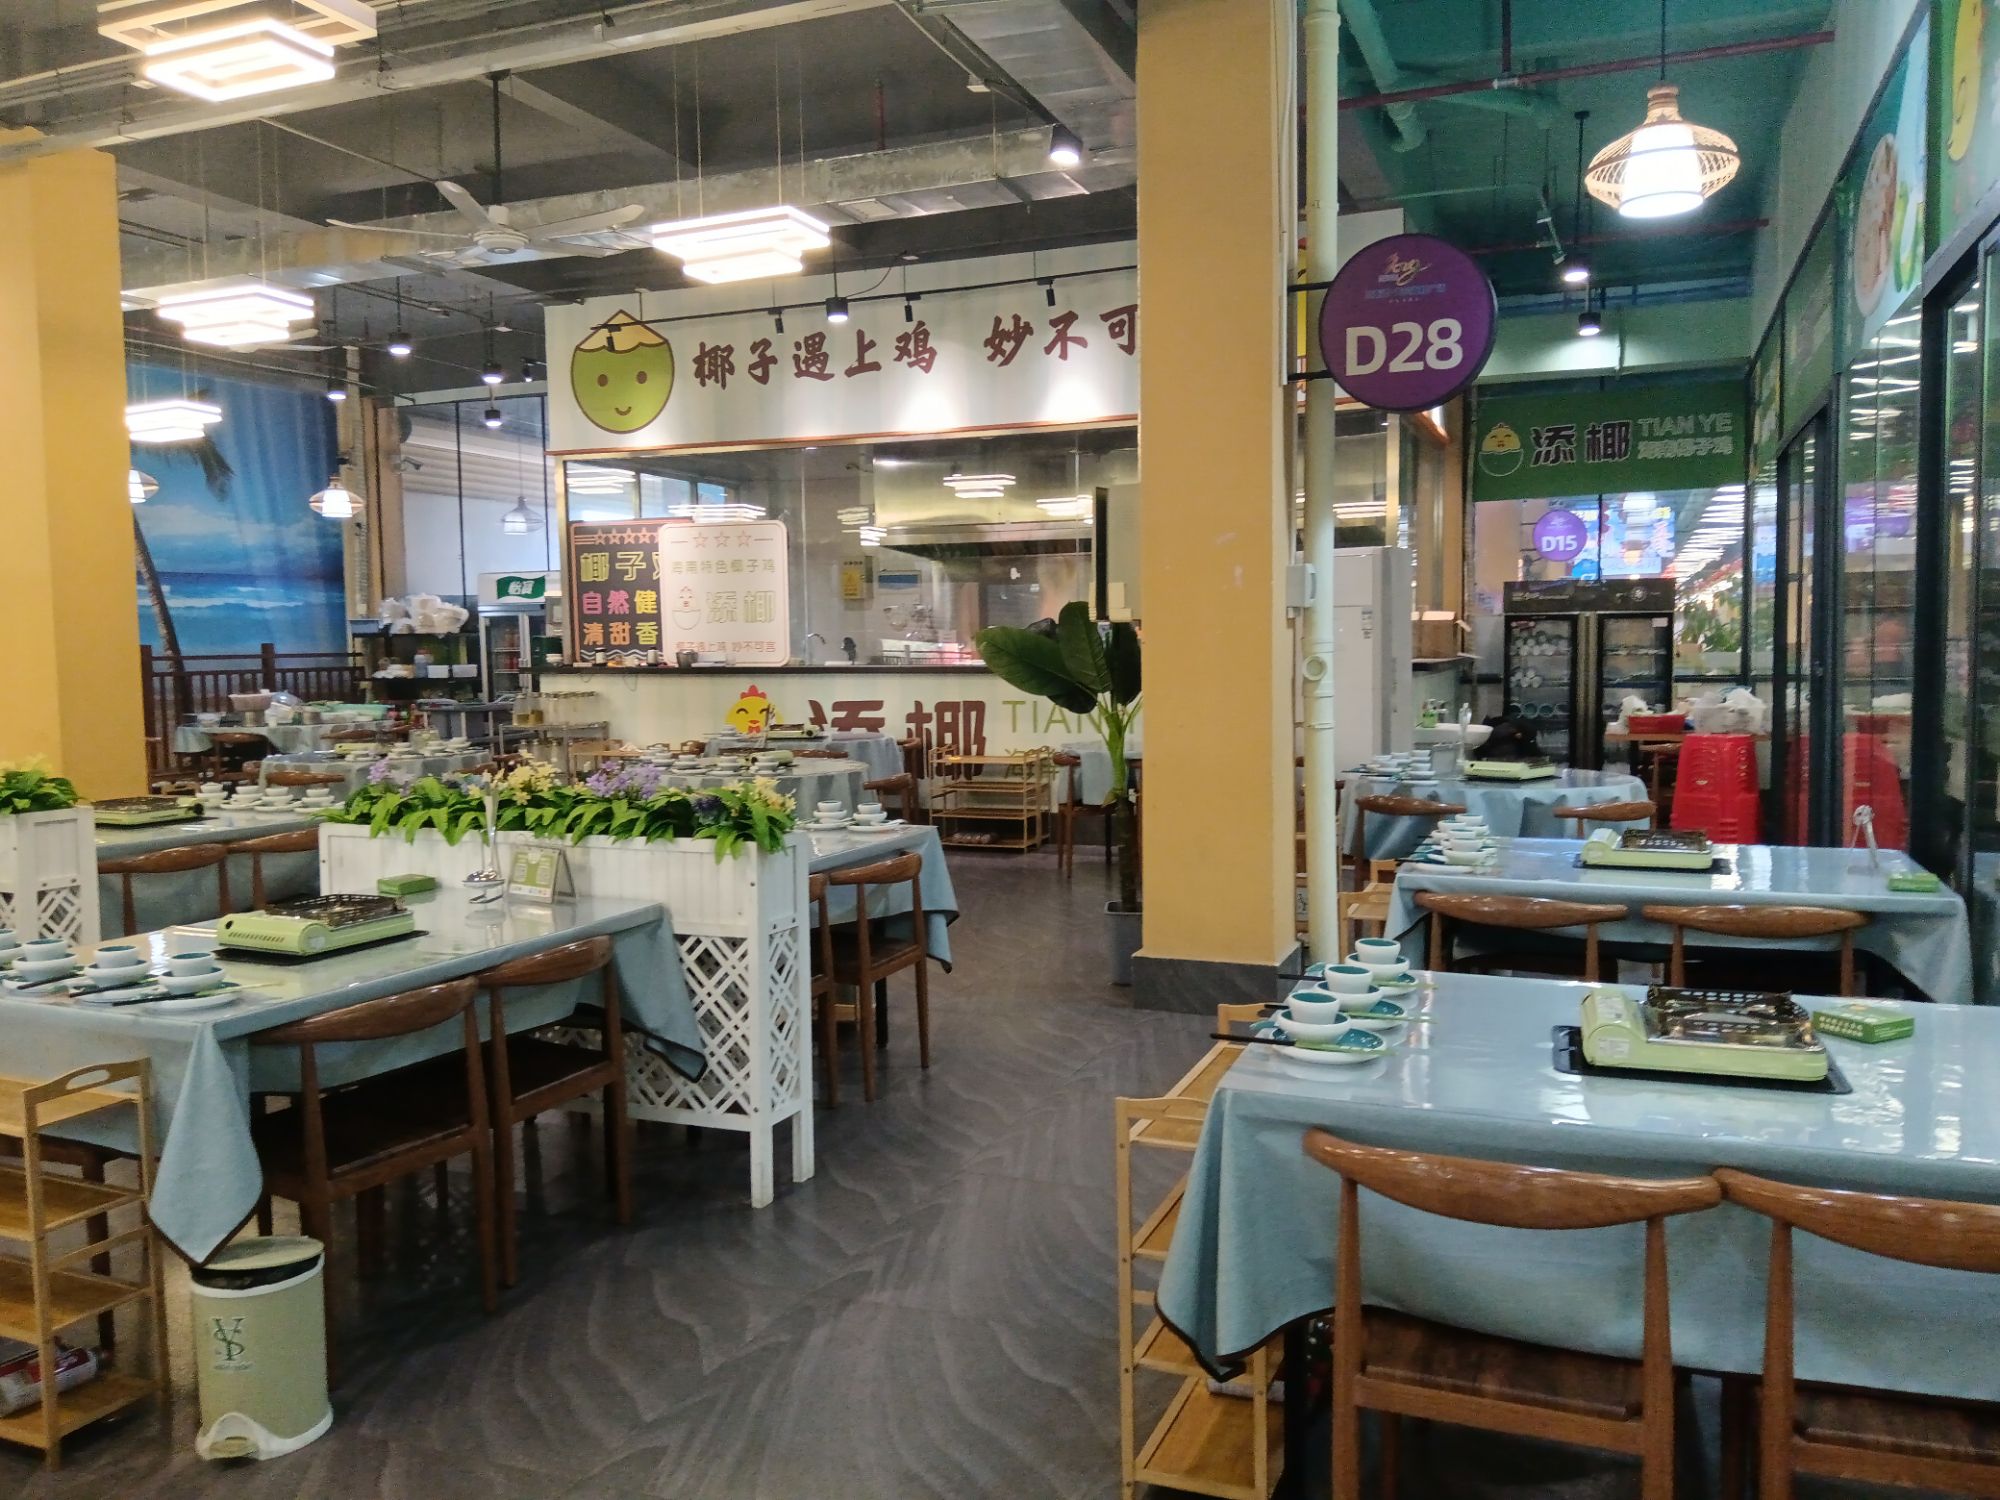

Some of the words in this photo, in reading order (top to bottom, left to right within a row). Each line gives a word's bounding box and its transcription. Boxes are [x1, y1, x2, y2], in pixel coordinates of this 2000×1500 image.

[692, 320, 939, 391] 椰子遇上鸡
[983, 303, 1139, 368] 妙不可
[1345, 318, 1464, 377] D28
[1637, 415, 1695, 437] TIAN
[1698, 412, 1734, 433] YE
[1530, 420, 1633, 468] 添椰
[1541, 535, 1578, 553] D15
[581, 589, 658, 616] 自然健
[705, 589, 776, 624] 添椰
[583, 621, 660, 646] 清甜香
